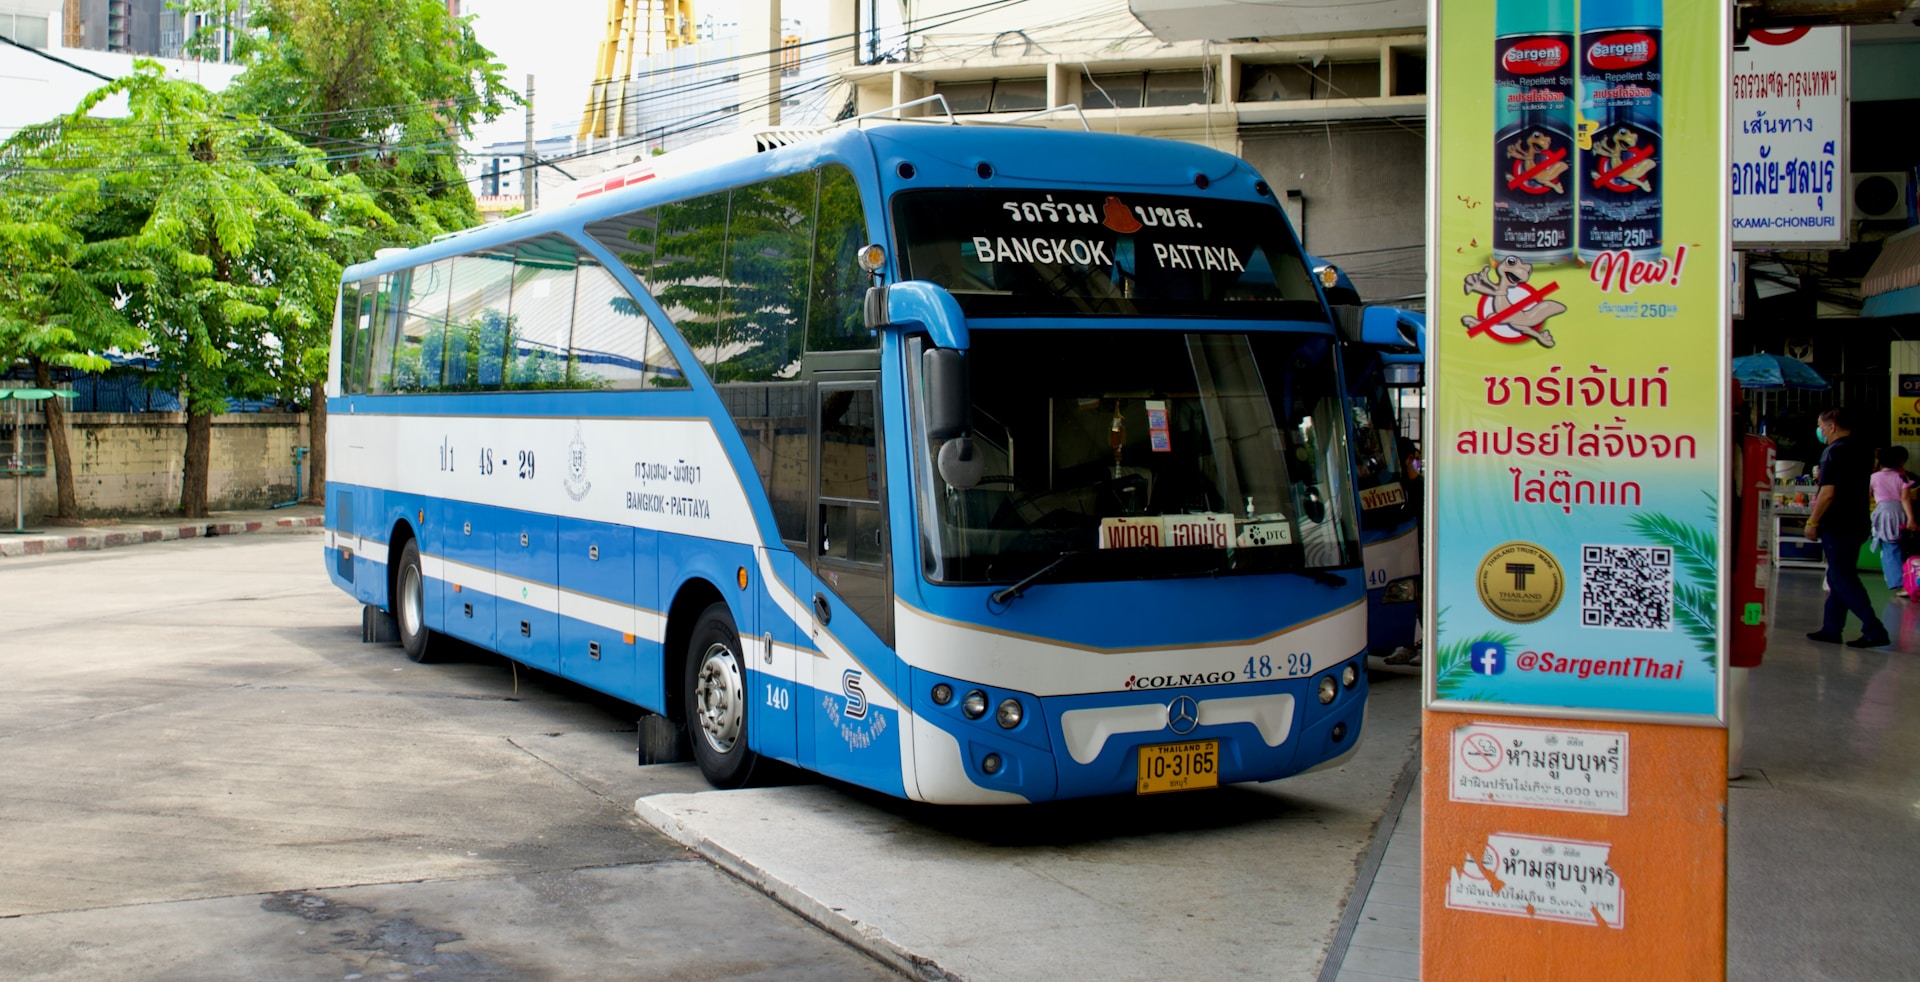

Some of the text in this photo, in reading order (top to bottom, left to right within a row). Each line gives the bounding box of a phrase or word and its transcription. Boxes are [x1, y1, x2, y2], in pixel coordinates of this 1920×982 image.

[1507, 46, 1561, 62] Sargent
[1592, 41, 1648, 57] Sargent
[1520, 77, 1556, 87] Repellent
[1605, 72, 1643, 82] Repellent
[1743, 110, 1813, 134] เส้นทาง
[1002, 195, 1203, 229] รถร่วม บขส.
[1537, 230, 1558, 247] 250
[1624, 229, 1646, 247] 250
[972, 236, 1245, 272] BANGKOK PATTAYA
[1589, 245, 1686, 293] New!
[1640, 304, 1667, 318] 250
[1484, 365, 1670, 407] ซาร์เจ้นท์
[1456, 416, 1697, 459] สเปรย์ไล่จิ้งจก
[480, 447, 493, 475] 48
[519, 449, 535, 480] 29
[1363, 489, 1404, 509] พัทยา
[1509, 467, 1642, 514] ไล่ตุ๊กแก
[626, 491, 665, 514] BANGKOK
[671, 496, 711, 520] PATTAYA
[1108, 516, 1228, 548] พัทยา เอกมัย
[1266, 529, 1287, 541] DTC
[1499, 592, 1542, 600] THAILAND
[1516, 651, 1684, 680] @SargentThai
[1136, 671, 1236, 689] COLNAGO
[766, 683, 789, 711] 140
[1158, 744, 1201, 754] THAILAND
[1506, 739, 1619, 783] ห้ามสูบบุหรี่
[1147, 752, 1214, 779] 10-3165
